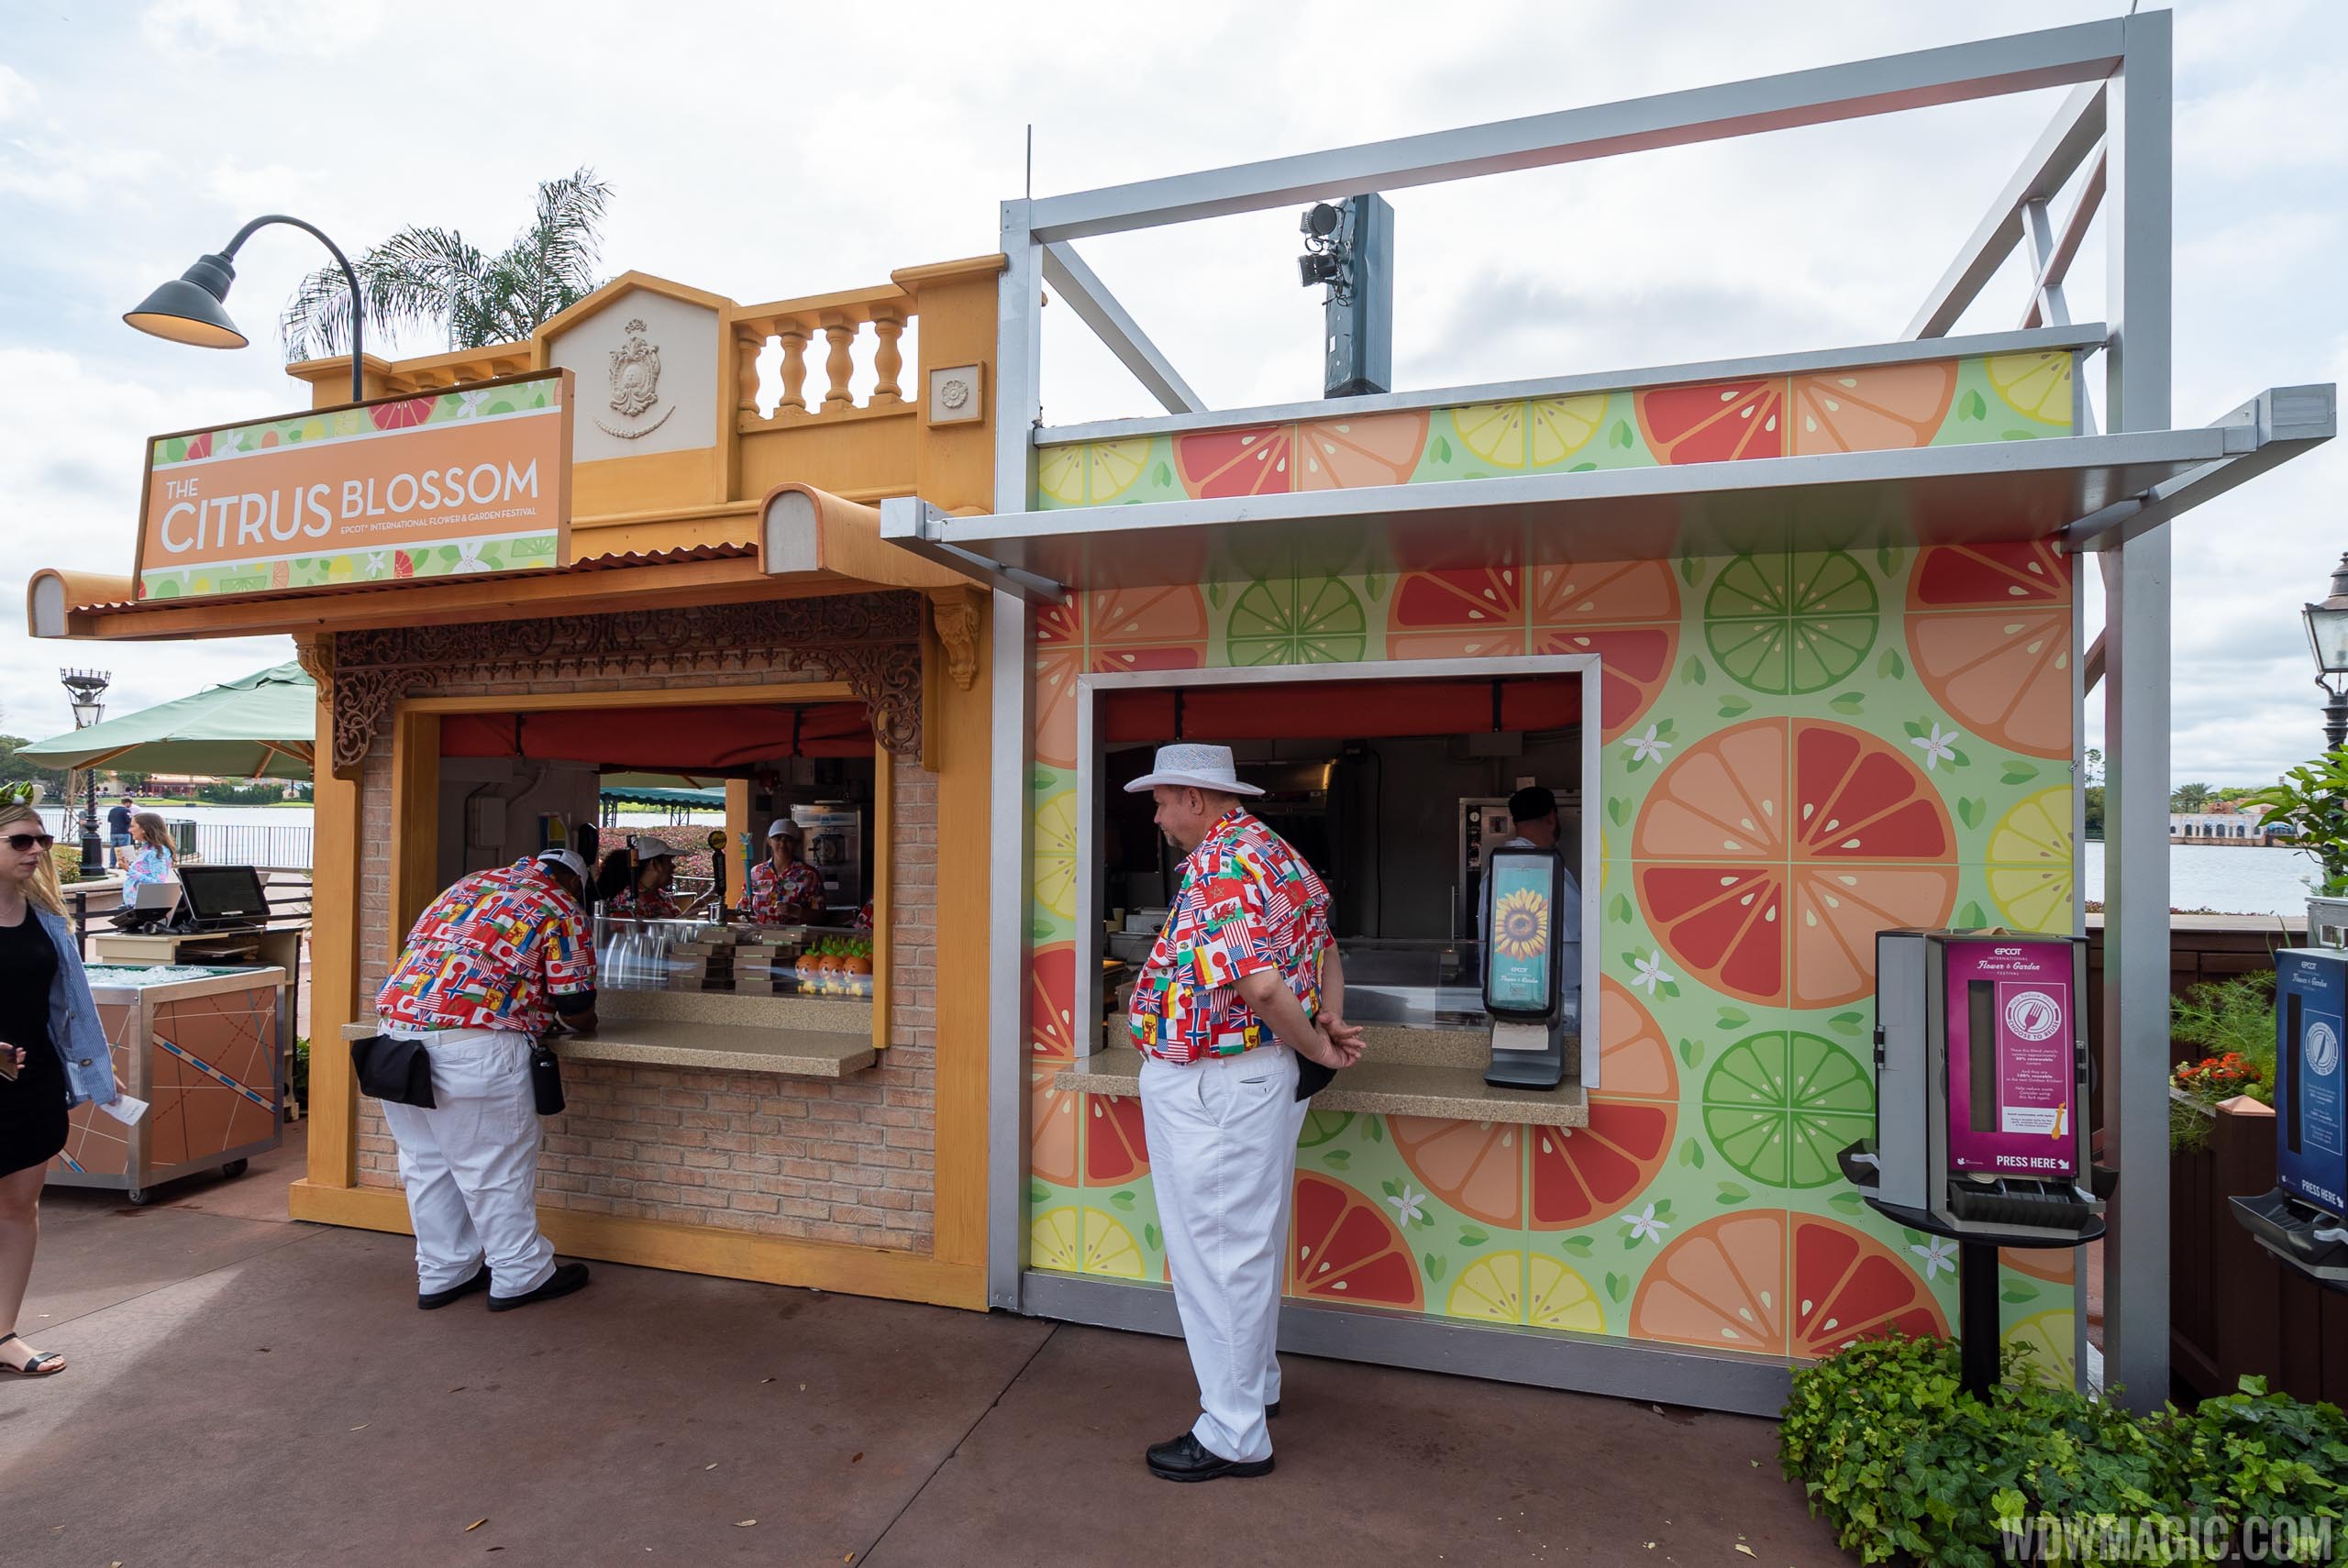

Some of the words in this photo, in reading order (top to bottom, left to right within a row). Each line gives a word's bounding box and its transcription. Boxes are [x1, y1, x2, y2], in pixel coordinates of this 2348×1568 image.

[166, 477, 198, 501] THE
[161, 482, 332, 554] CITRUS
[341, 458, 538, 519] BLOSSOM
[370, 519, 428, 532] INTERNATIONAL
[429, 515, 460, 526] FLOWER
[461, 513, 468, 523] &
[468, 511, 501, 523] GARDEN
[502, 507, 537, 518] FESTIVAL
[1994, 947, 2022, 955] EPCOT
[1977, 959, 2004, 969] Flower
[2012, 961, 2041, 970] Garden
[2008, 1020, 2032, 1040] CHOOSE
[2043, 1021, 2060, 1036] REUSE
[1996, 1154, 2028, 1167] PRESS
[2030, 1156, 2057, 1169] HERE
[2301, 1178, 2320, 1198] PRESS
[2320, 1187, 2337, 1205] HERE
